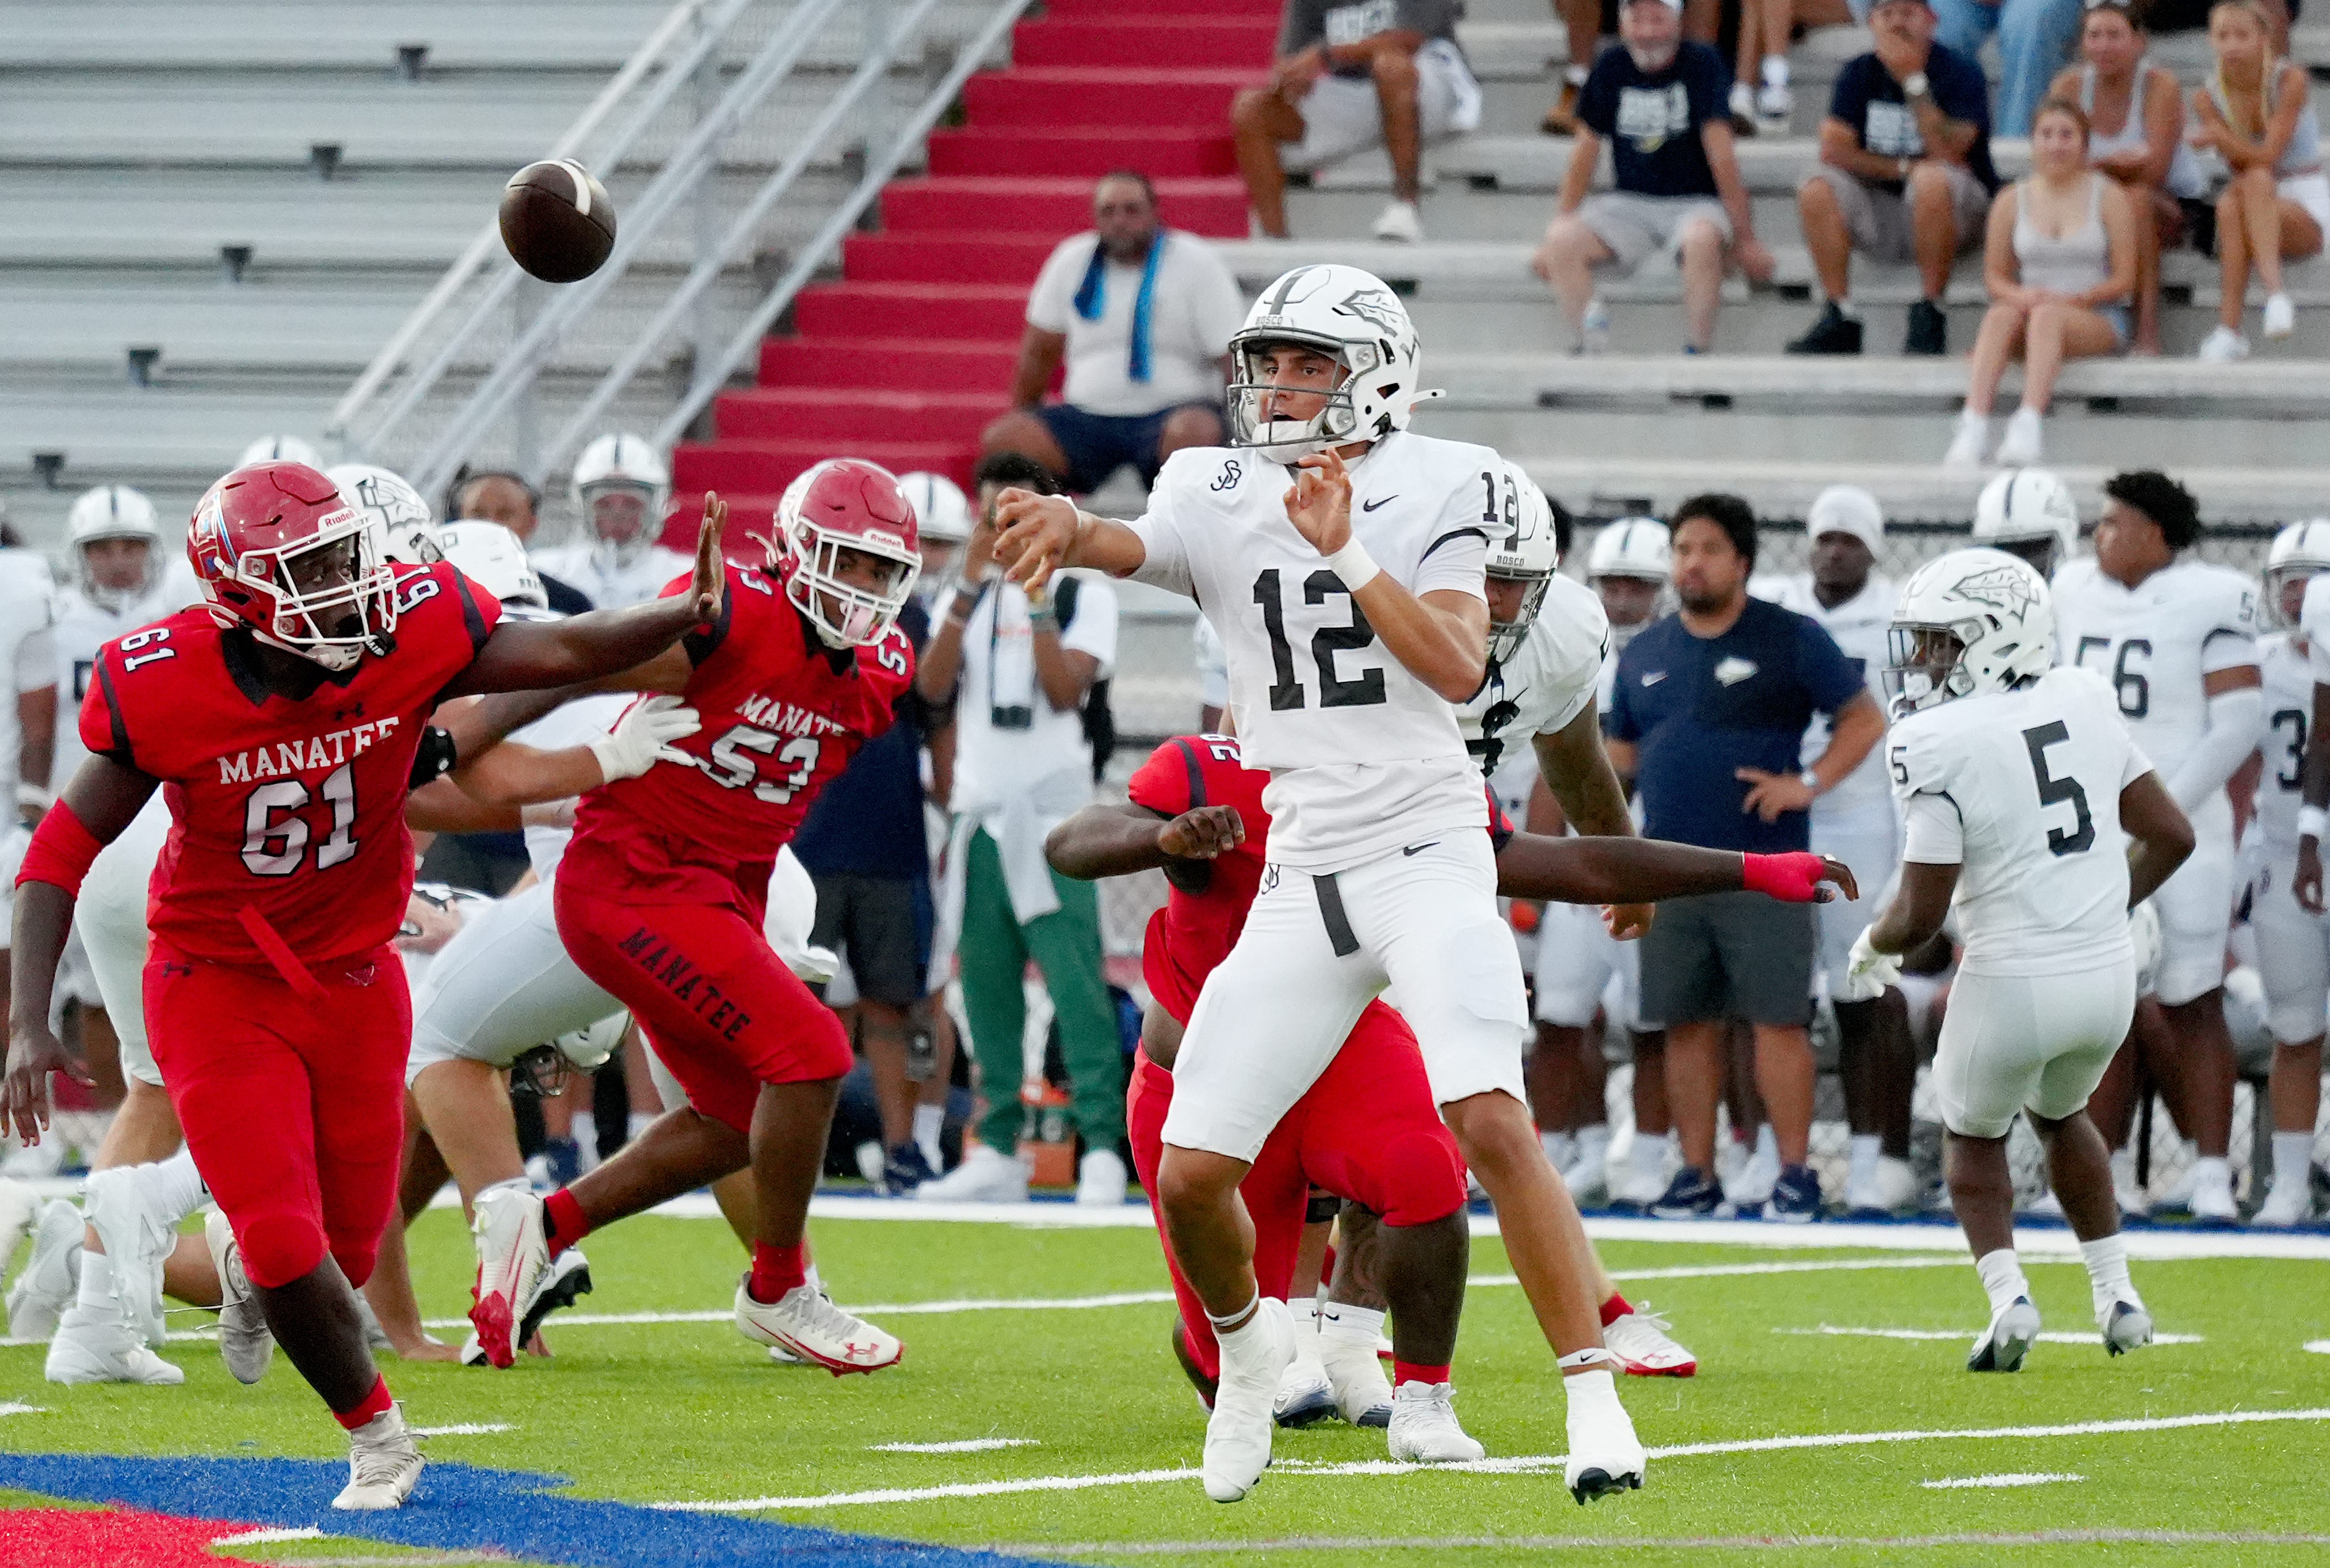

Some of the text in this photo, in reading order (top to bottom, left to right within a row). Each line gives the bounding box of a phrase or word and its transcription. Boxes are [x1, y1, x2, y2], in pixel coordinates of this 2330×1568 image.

[325, 509, 355, 528] Riddell
[871, 533, 902, 548] Riddell
[120, 627, 176, 673] 61
[1253, 569, 1387, 711] 12
[690, 723, 820, 806] 53
[1892, 746, 1908, 786] 5
[2021, 719, 2096, 857] 5
[241, 761, 359, 876] 61
[619, 927, 752, 1041] MANATEE
